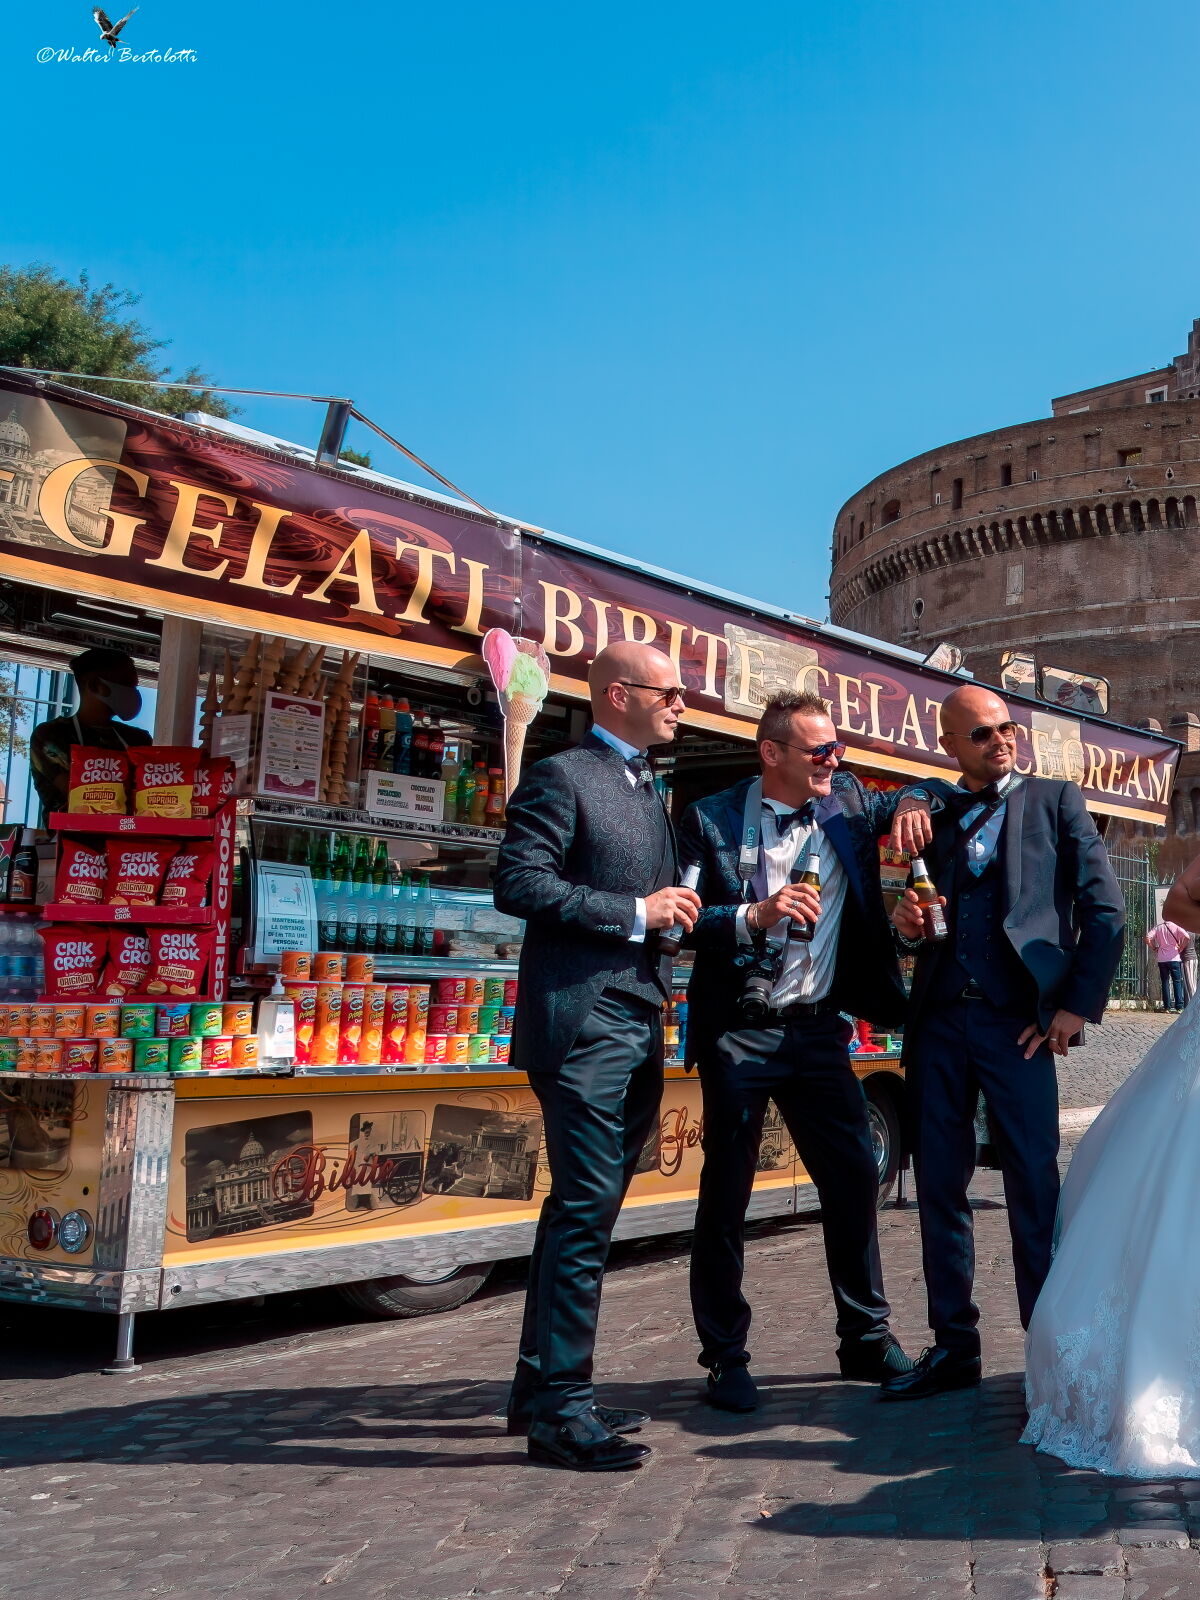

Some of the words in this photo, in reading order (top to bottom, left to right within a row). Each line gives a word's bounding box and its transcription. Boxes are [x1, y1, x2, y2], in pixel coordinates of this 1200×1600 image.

[38, 457, 490, 637] GELATI
[795, 665, 949, 756] GELAT
[1063, 738, 1173, 806] CREAM
[83, 758, 122, 771] CRIK
[144, 762, 182, 774] CRIK
[80, 769, 124, 784] CROK
[142, 770, 185, 787] CROK
[74, 850, 108, 866] CRIK
[120, 851, 159, 863] CRIK
[171, 855, 199, 867] RIK
[217, 812, 231, 910] CROK
[68, 863, 109, 880] CROK
[118, 862, 161, 877] CROK
[167, 866, 195, 880] ROK
[123, 936, 149, 950] CRI
[160, 933, 199, 948] CRIK
[55, 941, 94, 956] CRIK
[158, 947, 201, 961] CROK
[53, 955, 97, 971] CROK
[119, 950, 151, 965] CRO
[213, 919, 227, 1002] CRIK
[271, 1143, 397, 1206] Bibite
